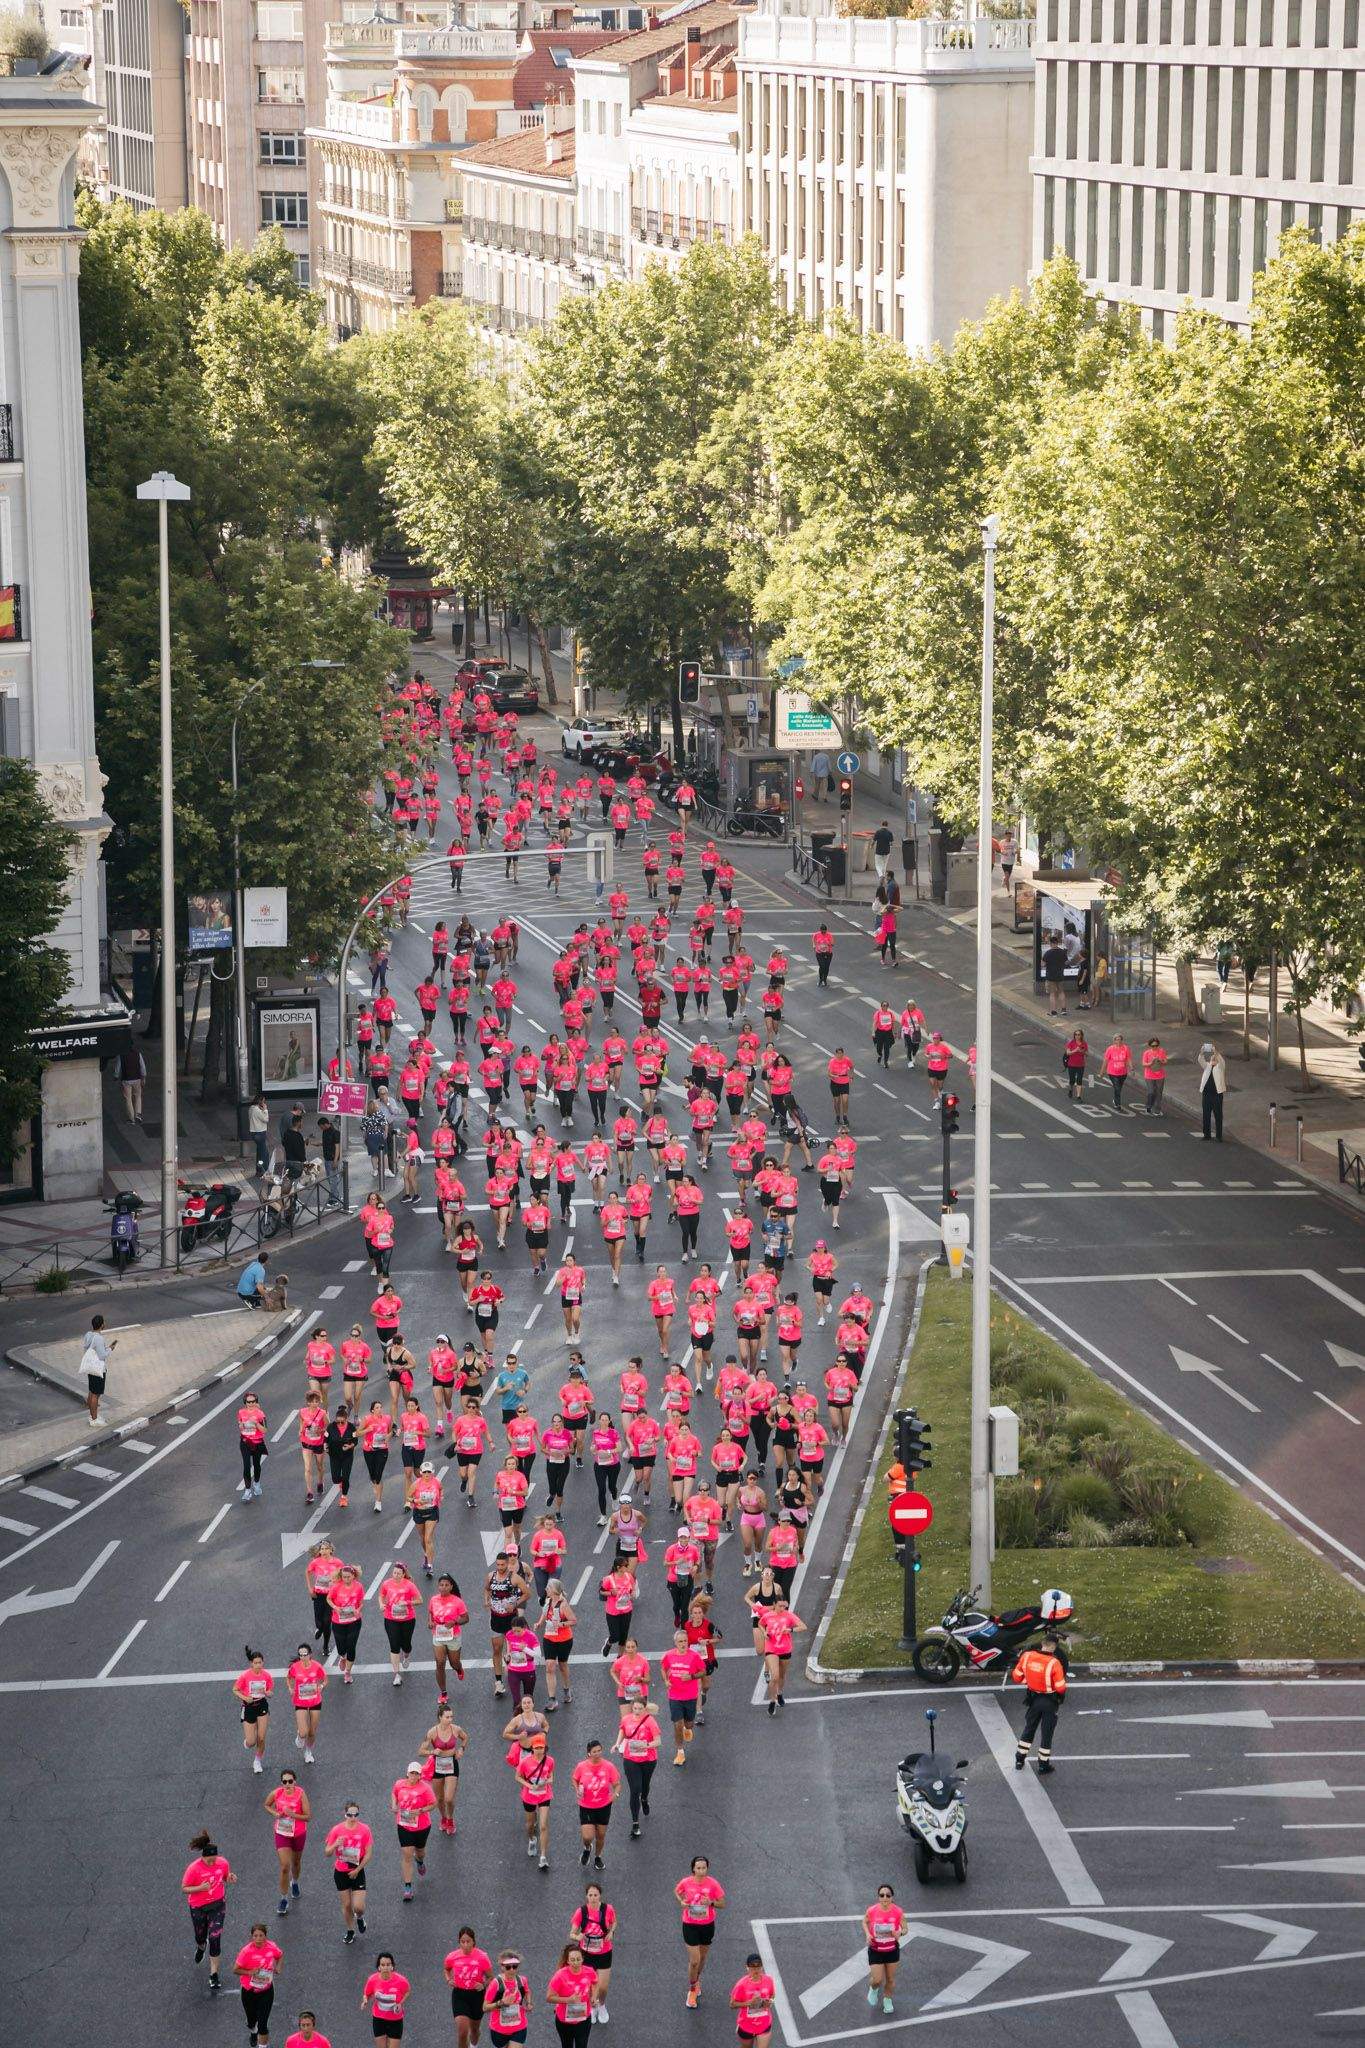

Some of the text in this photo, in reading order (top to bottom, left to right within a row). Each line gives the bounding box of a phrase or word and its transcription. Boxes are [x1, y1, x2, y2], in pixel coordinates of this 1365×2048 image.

[263, 1012, 313, 1023] SIMORRA
[37, 1036, 98, 1050] WELFARE
[325, 1083, 344, 1095] Km
[327, 1094, 339, 1112] 3
[1071, 1102, 1163, 1118] BUS
